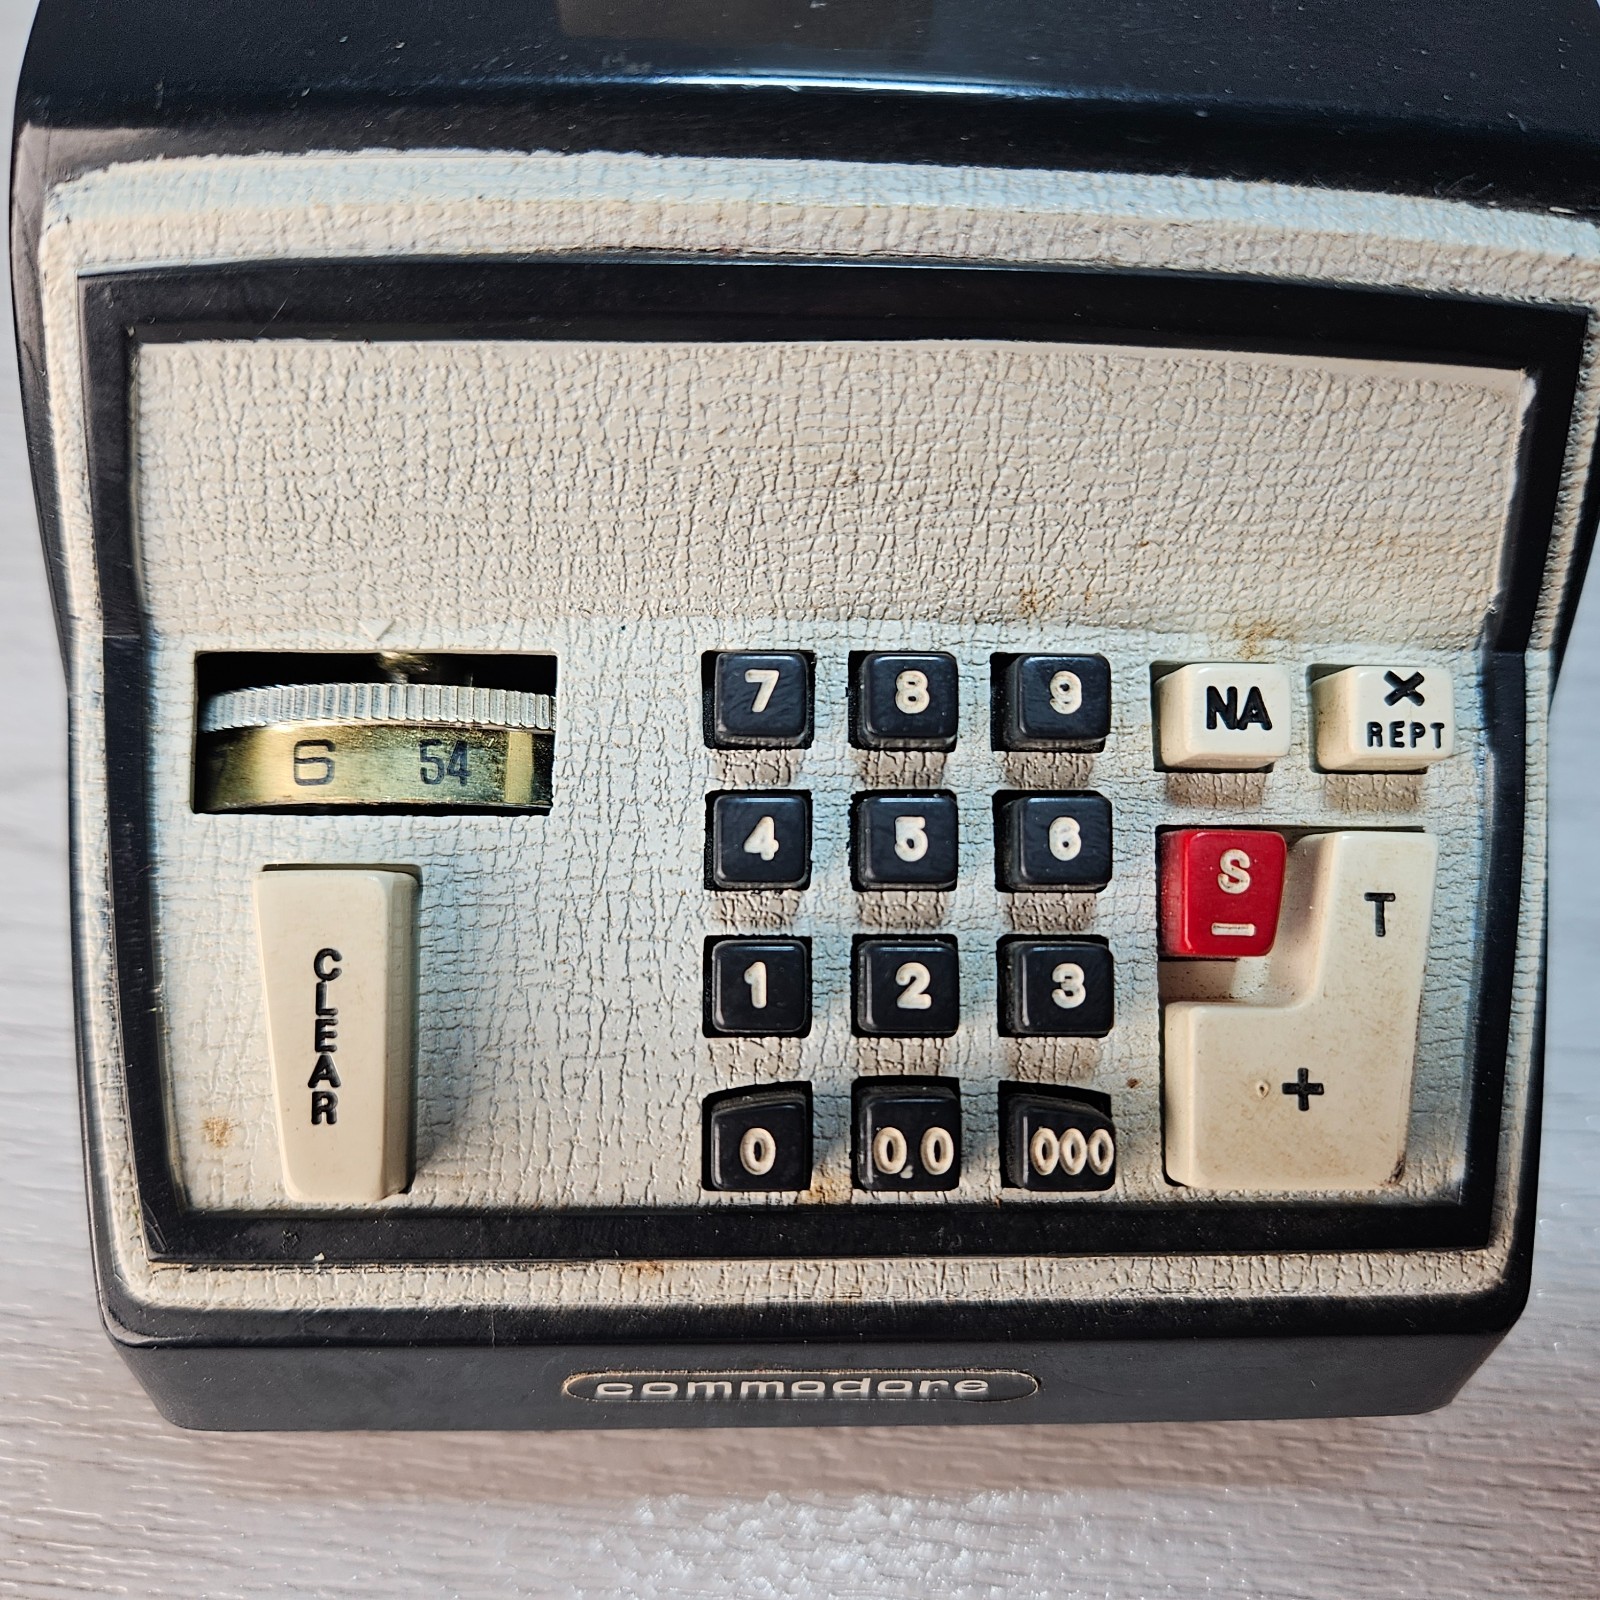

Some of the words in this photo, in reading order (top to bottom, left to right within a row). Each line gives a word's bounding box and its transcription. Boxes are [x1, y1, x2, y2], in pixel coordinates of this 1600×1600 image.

[744, 669, 780, 713] 7
[895, 670, 930, 714] 8
[1049, 670, 1082, 714] 9
[1206, 685, 1273, 731] NA
[1367, 720, 1445, 749] REPT
[293, 739, 336, 786] 6
[419, 739, 472, 786] 54
[743, 816, 779, 861] 4
[894, 816, 928, 862] 5
[1048, 816, 1082, 862] 6
[1217, 848, 1251, 894] S
[1364, 892, 1396, 937] T
[744, 961, 768, 1009] 1
[895, 962, 932, 1010] 2
[1051, 962, 1087, 1010] 3
[307, 947, 343, 1125] CLEAR
[739, 1127, 776, 1176] 0
[1029, 1126, 1115, 1176] 000
[596, 1376, 989, 1398] commodore
